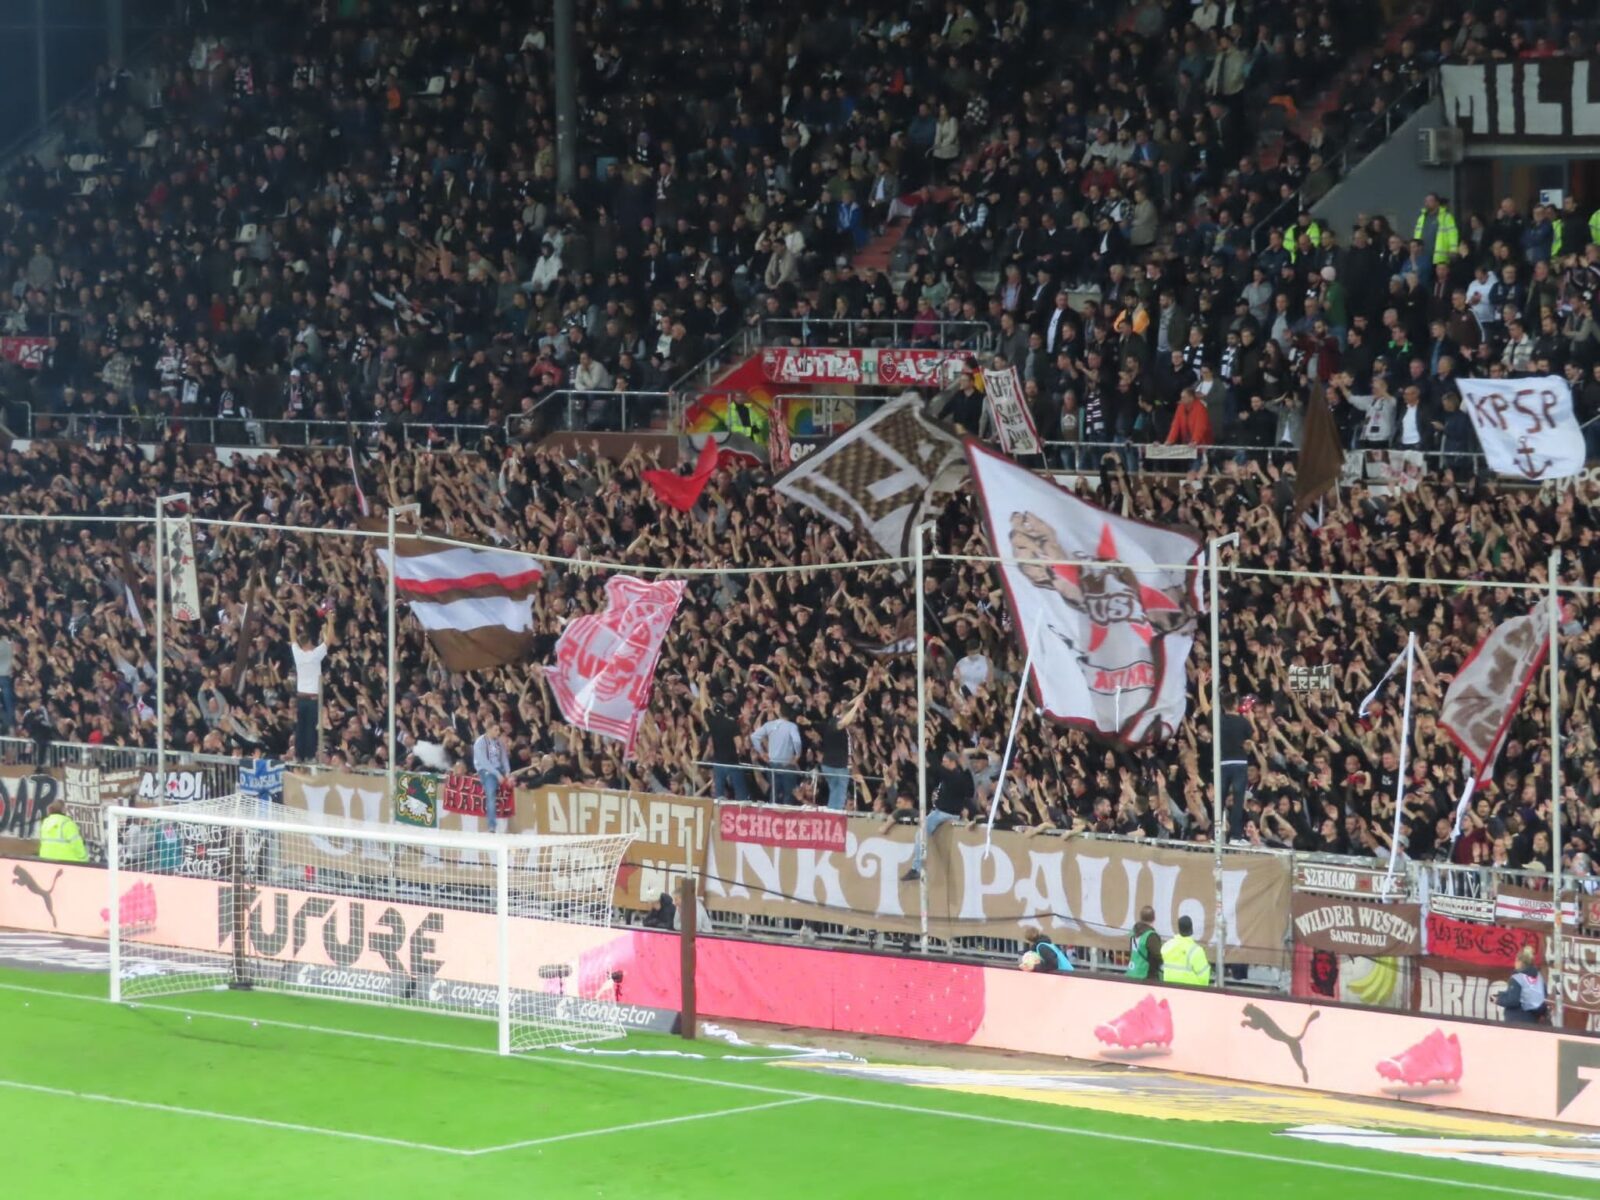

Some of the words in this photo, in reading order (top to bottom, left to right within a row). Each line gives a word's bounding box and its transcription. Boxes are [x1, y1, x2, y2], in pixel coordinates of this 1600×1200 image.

[1466, 389, 1558, 434] KPSP
[1288, 675, 1330, 690] CREW
[548, 792, 704, 850] DIFFIDATI
[720, 807, 846, 848] SCHICKERIA
[1304, 868, 1356, 890] SZENARIO
[957, 842, 1247, 947] PAULI
[1295, 905, 1354, 936] WILDER
[1358, 906, 1418, 945] WESTEN
[1330, 929, 1360, 944] SANKT
[1361, 934, 1387, 946] PAULI
[320, 967, 391, 994] congstar
[451, 984, 521, 1008] congstr
[580, 998, 656, 1025] congstar
